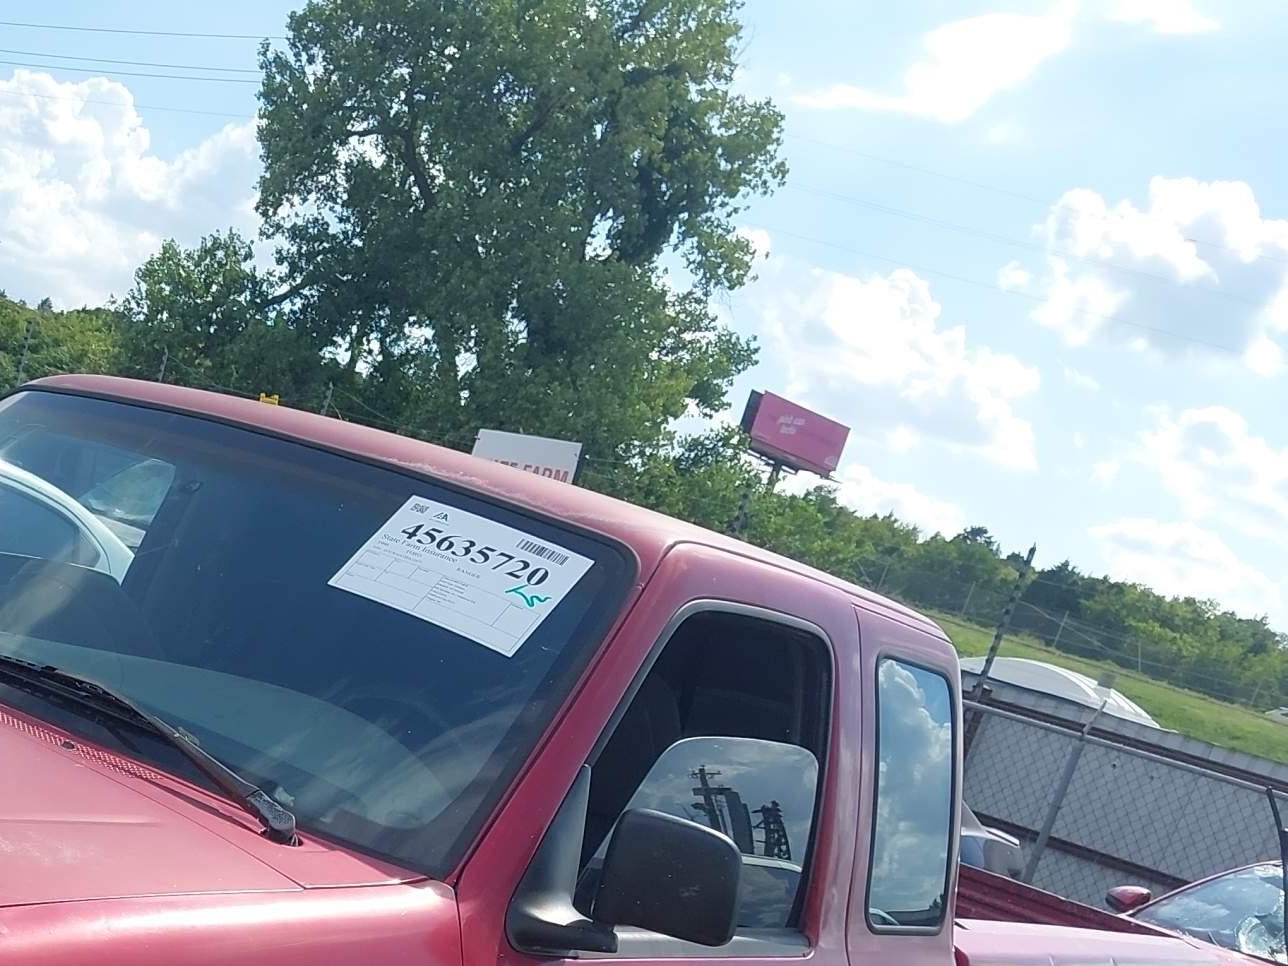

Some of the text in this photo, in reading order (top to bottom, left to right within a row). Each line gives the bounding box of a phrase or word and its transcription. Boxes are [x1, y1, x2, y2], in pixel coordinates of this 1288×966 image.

[382, 533, 401, 544] State
[402, 539, 421, 551] Farm
[422, 546, 458, 563] Insurance
[401, 523, 549, 586] 45635720
